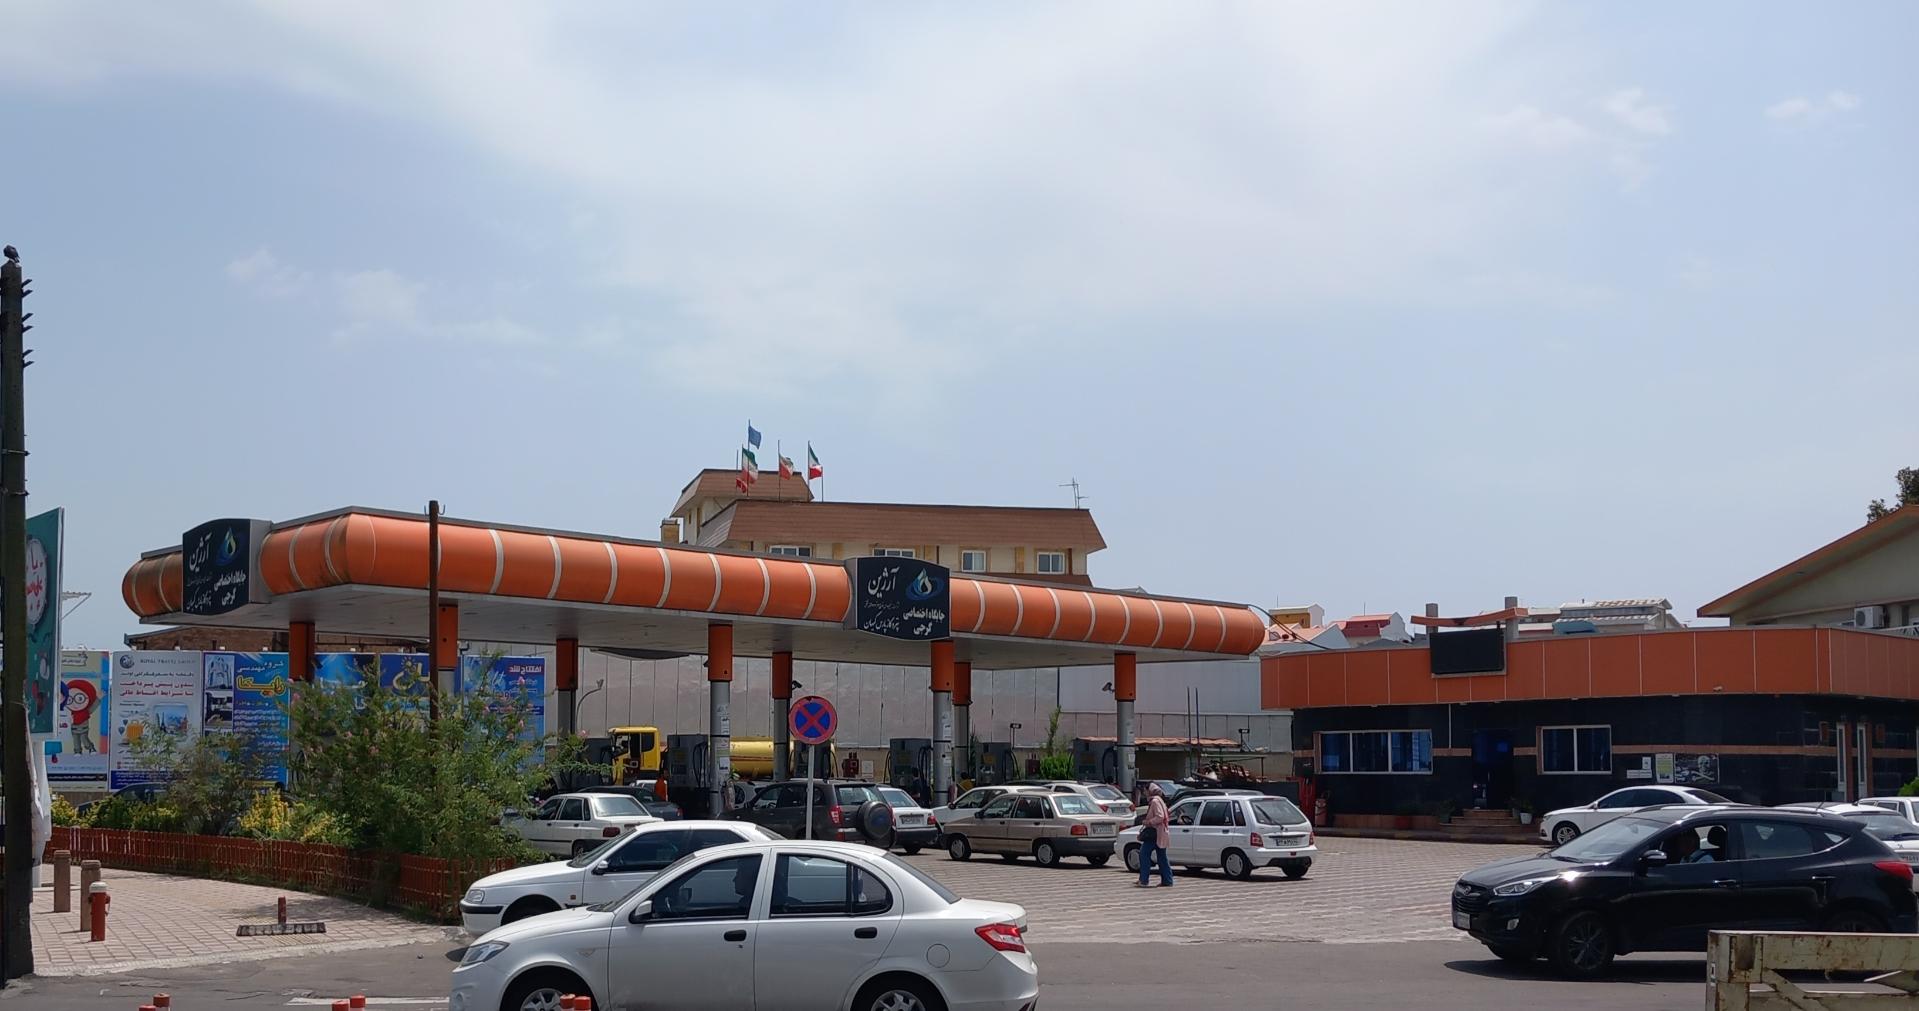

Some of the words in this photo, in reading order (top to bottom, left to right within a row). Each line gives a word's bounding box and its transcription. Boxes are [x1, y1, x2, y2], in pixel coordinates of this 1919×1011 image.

[189, 532, 212, 572] آرژین
[867, 566, 901, 598] آرژین
[903, 607, 928, 620] اختصاصی
[928, 608, 945, 623] جایگاه
[913, 621, 933, 636] گرجی
[509, 665, 521, 673] شد
[520, 665, 541, 675] افتتاح
